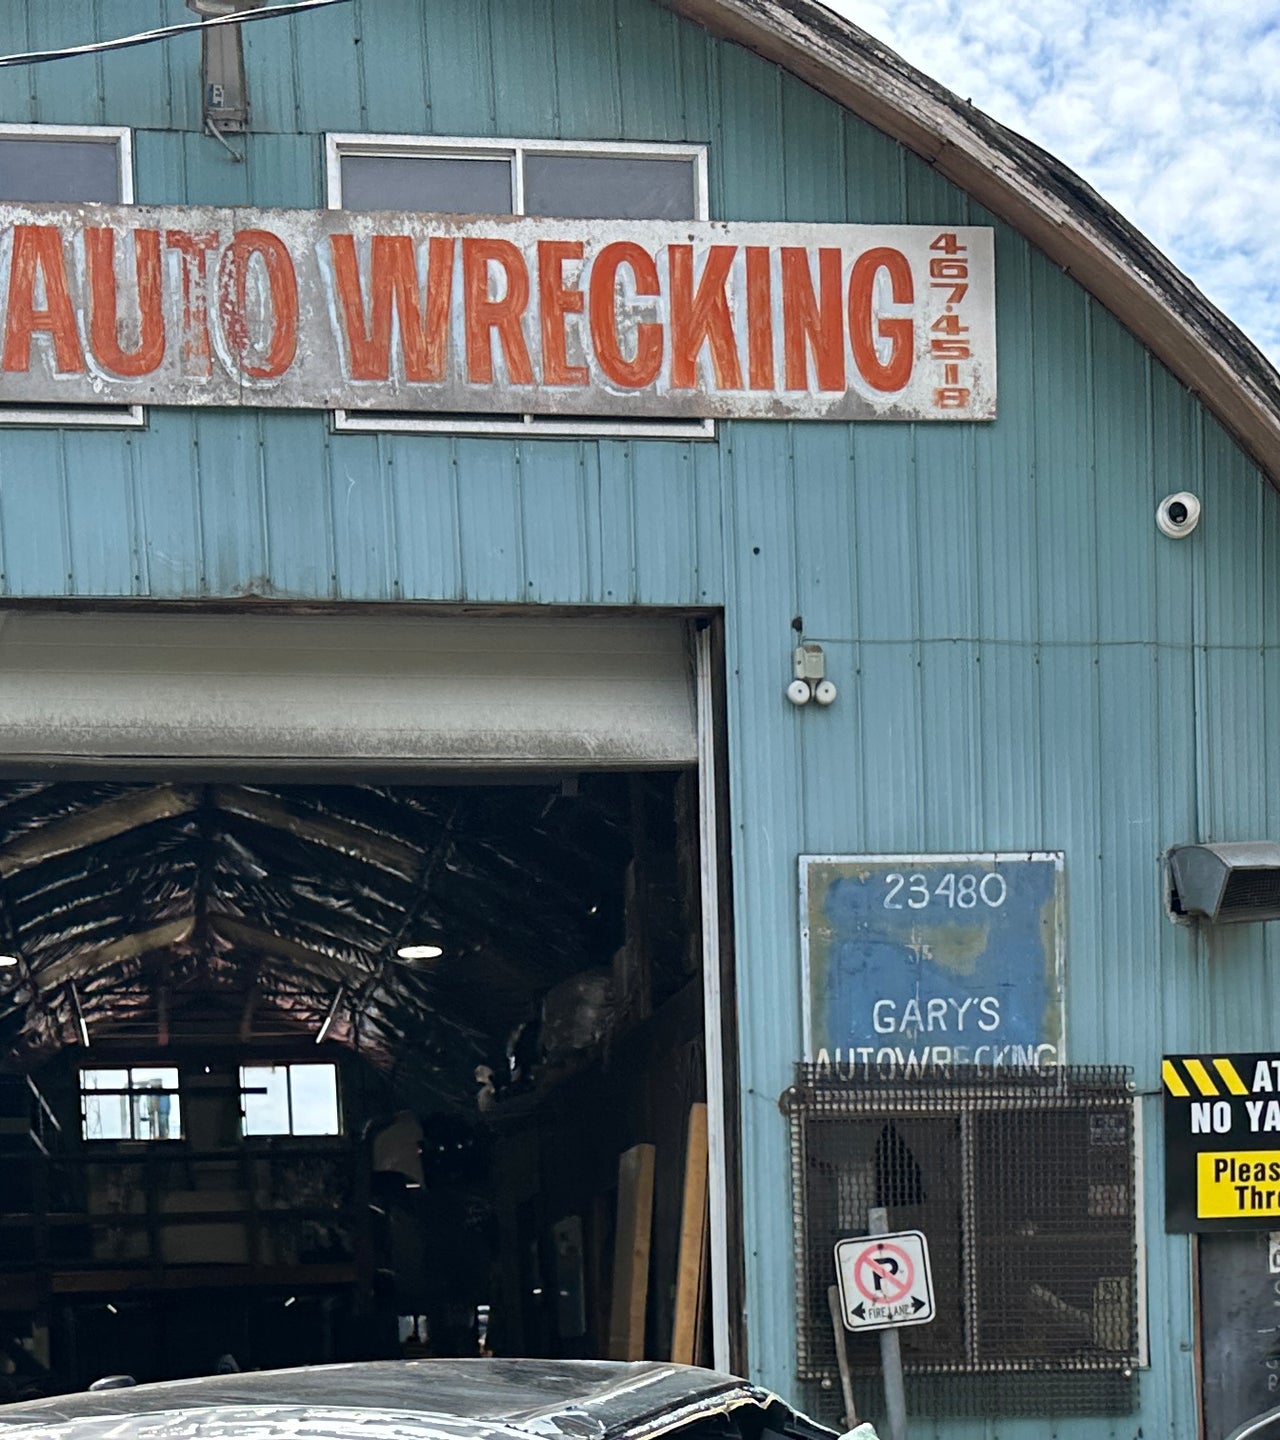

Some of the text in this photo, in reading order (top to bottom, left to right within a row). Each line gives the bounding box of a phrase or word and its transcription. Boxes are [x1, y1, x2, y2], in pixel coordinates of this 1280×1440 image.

[1, 226, 299, 381] AUTO
[329, 233, 915, 393] WRECKING
[883, 872, 1007, 909] 23480
[872, 996, 1000, 1034] GARY'S
[1190, 1101, 1232, 1133] NO
